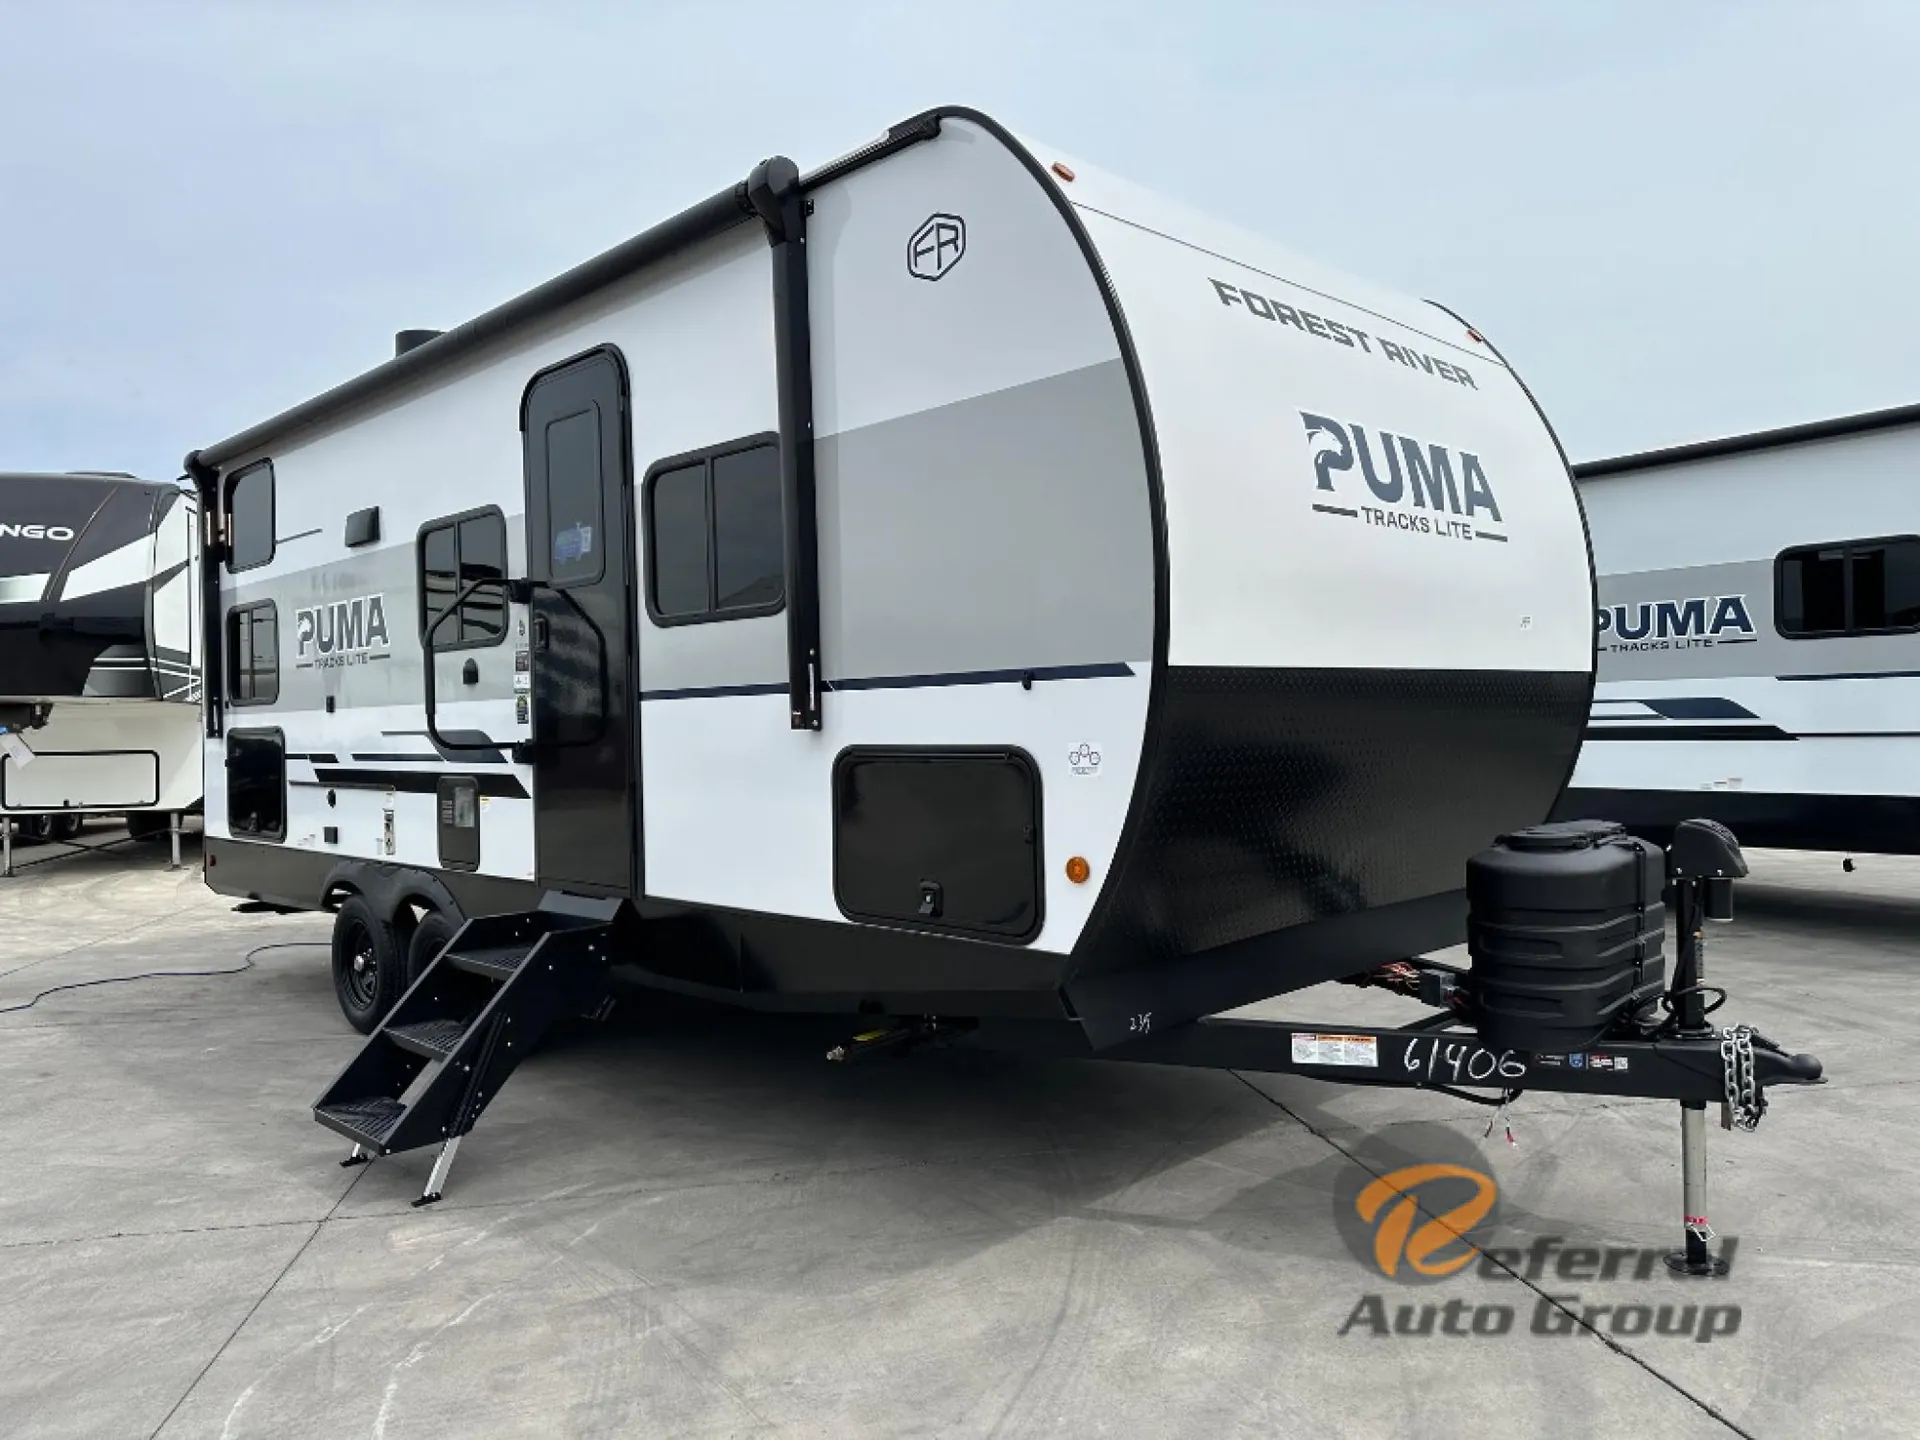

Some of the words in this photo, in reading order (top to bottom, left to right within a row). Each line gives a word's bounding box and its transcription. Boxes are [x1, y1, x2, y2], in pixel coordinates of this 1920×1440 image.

[1207, 277, 1371, 353] FOREST
[1375, 336, 1479, 391] RIVER
[1299, 410, 1502, 522] PUMA
[1361, 506, 1430, 534] TRACKS
[1434, 519, 1473, 541] LITE
[296, 593, 390, 658] PUMA
[1610, 640, 1670, 653] TRACKS
[1675, 637, 1714, 650] LITE
[1403, 1037, 1528, 1083] 61406
